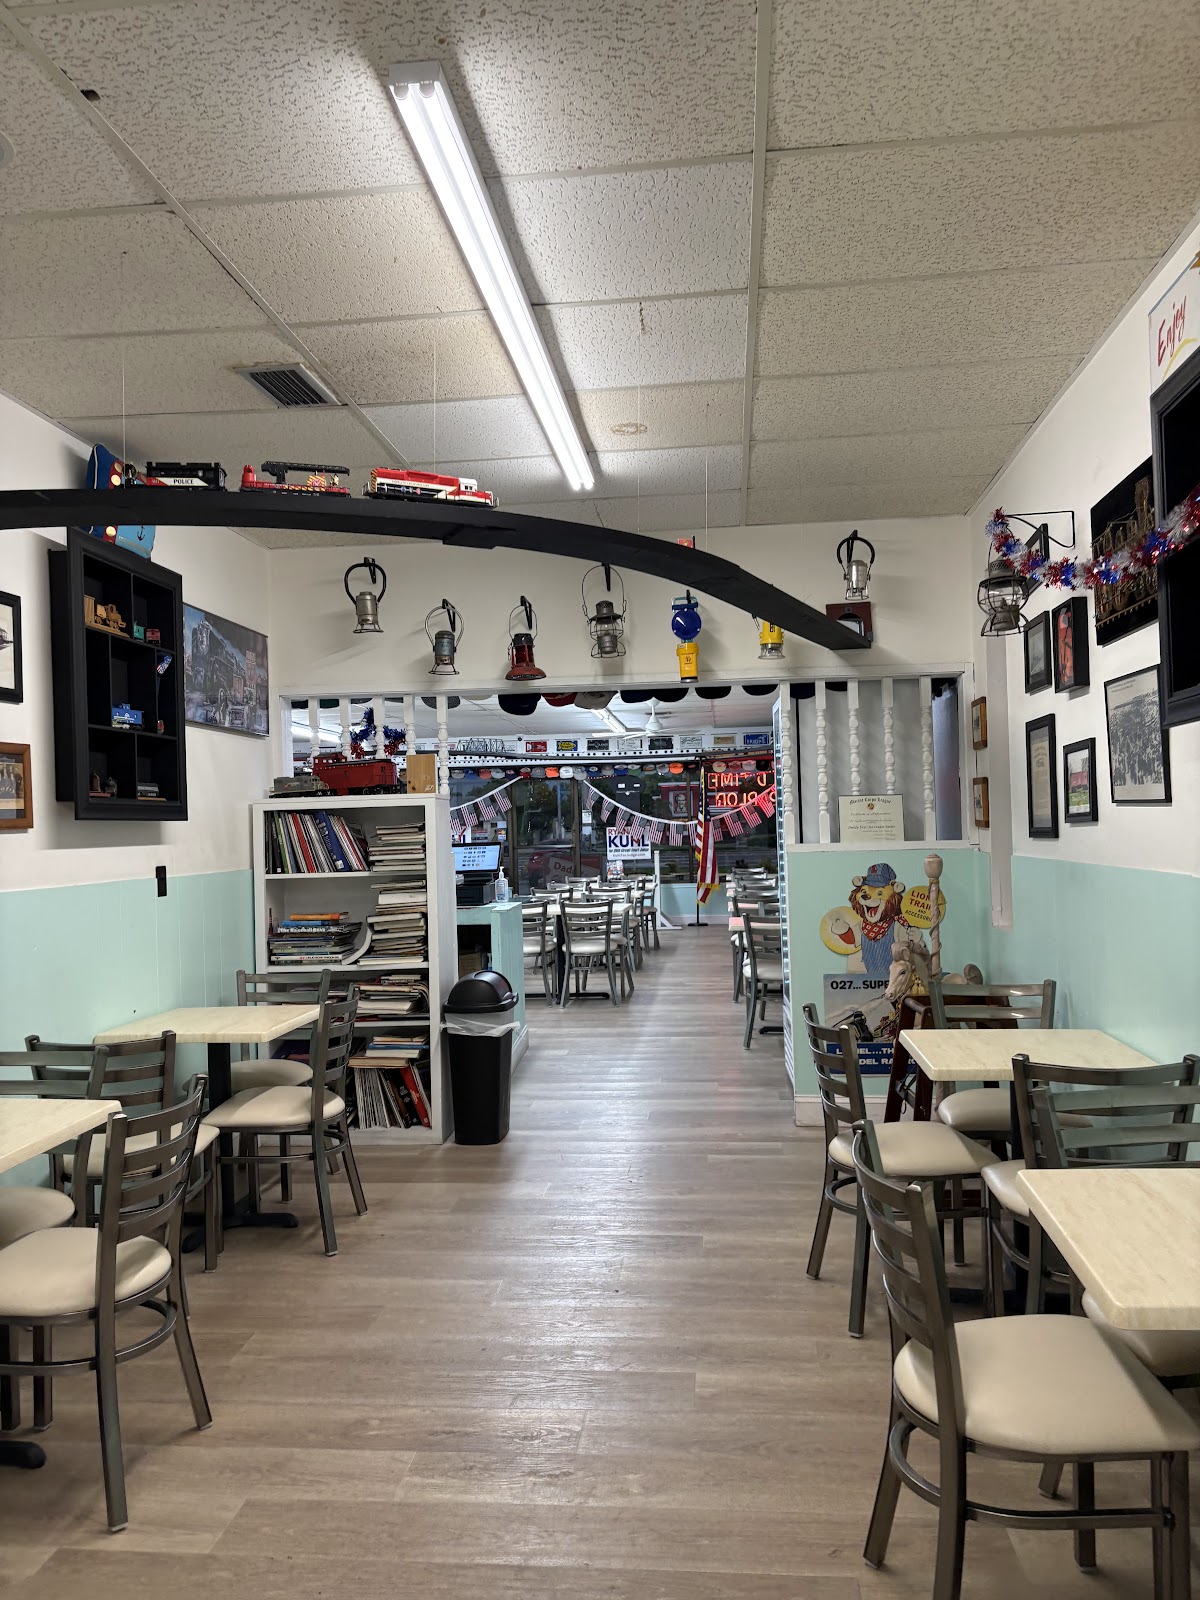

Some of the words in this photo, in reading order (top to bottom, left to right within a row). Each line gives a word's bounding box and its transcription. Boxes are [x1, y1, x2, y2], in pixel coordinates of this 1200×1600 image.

[1158, 295, 1187, 367] Enjoy
[911, 890, 930, 900] LION
[909, 898, 931, 910] TRAI
[905, 909, 931, 922] ACCESSOR
